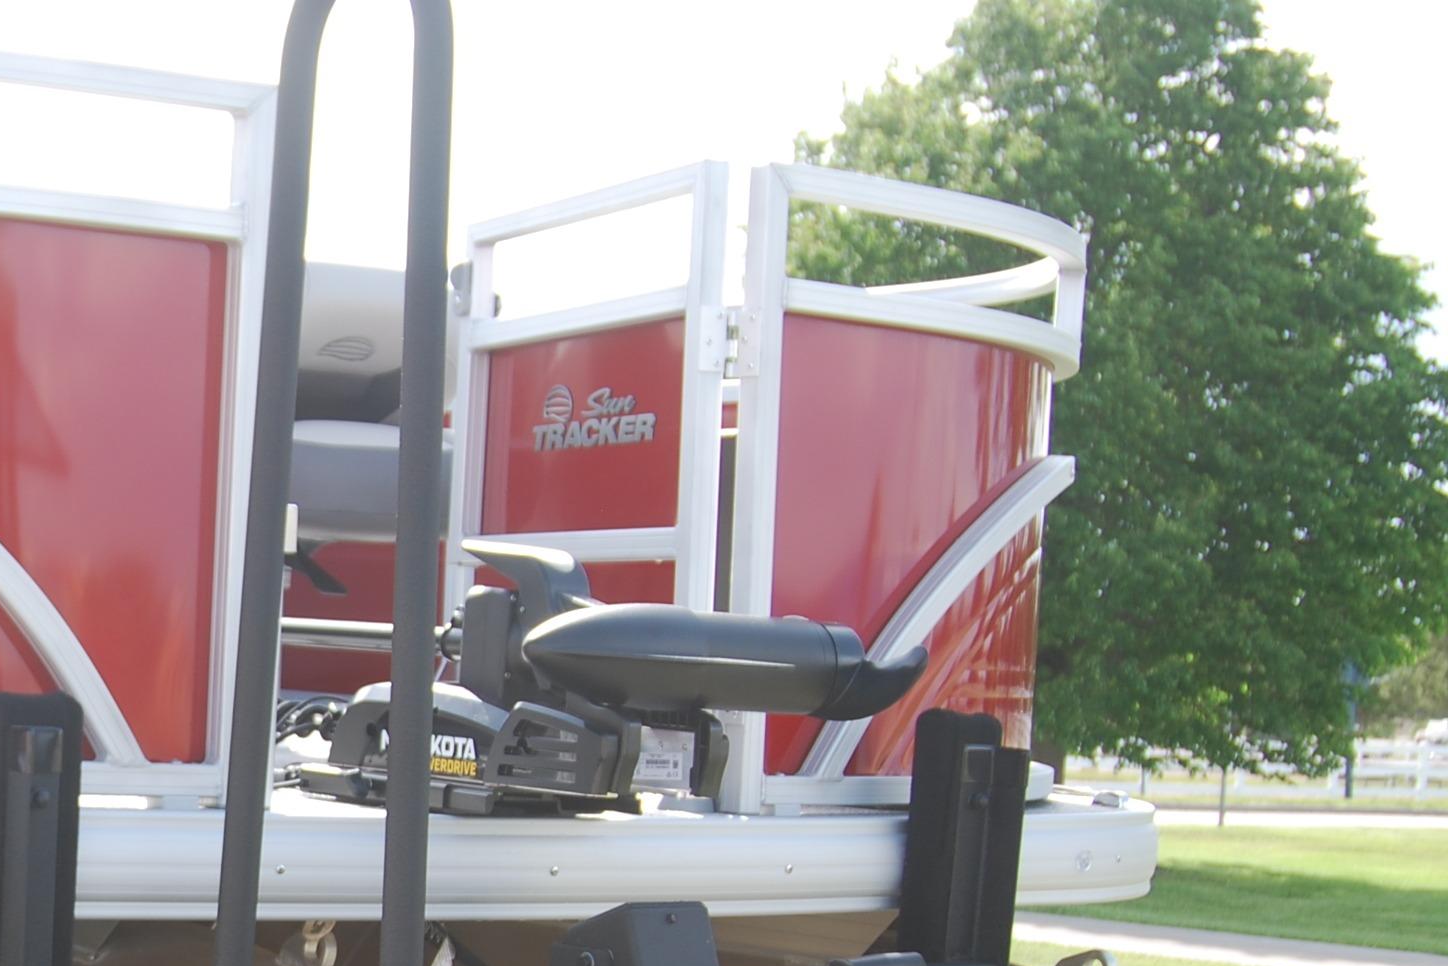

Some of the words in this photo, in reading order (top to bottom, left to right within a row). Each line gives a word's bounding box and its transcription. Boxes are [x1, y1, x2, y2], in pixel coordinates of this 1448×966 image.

[580, 387, 636, 417] Sun
[532, 412, 657, 452] TRACKER
[430, 733, 477, 760] KOTA
[429, 756, 477, 777] VERDRIVE
